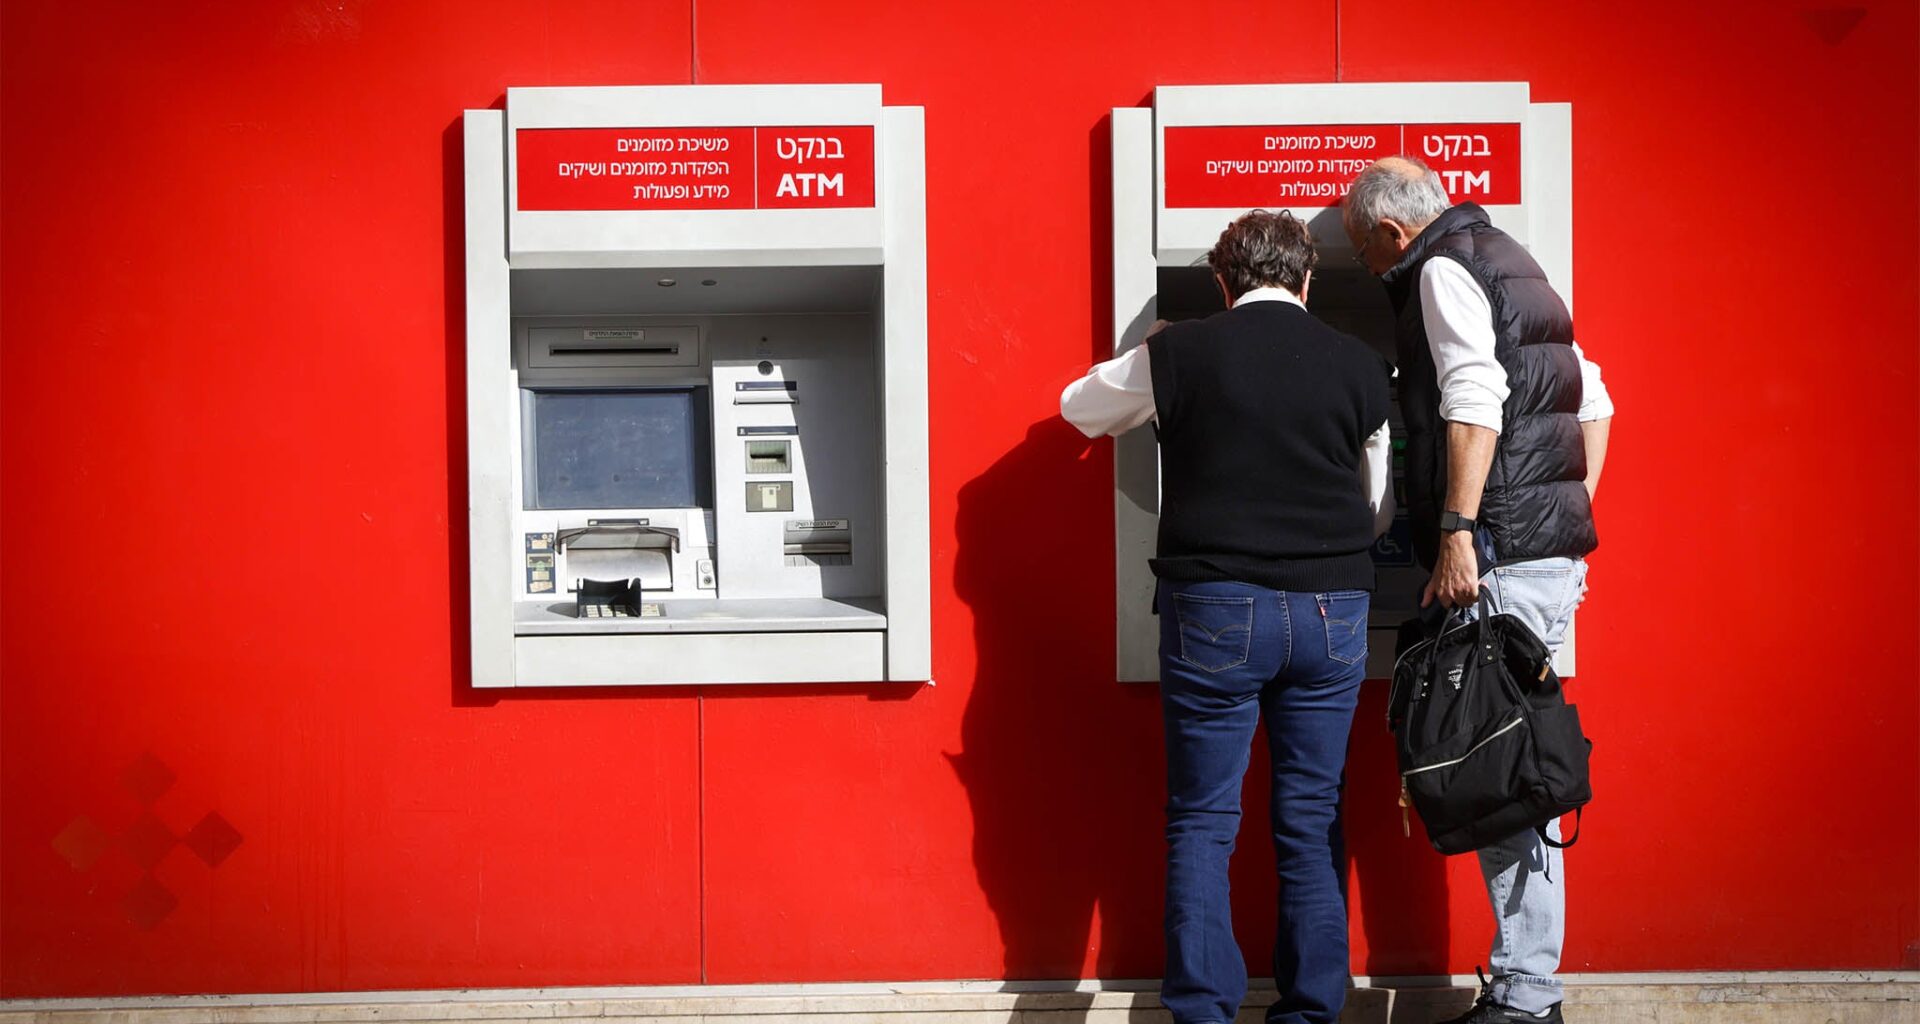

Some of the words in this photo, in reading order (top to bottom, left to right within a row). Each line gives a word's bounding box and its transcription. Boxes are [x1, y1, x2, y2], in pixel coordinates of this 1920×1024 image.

[617, 138, 674, 152] מזומנים
[678, 137, 729, 152] משיכת
[776, 137, 845, 163] בנקט
[1264, 136, 1321, 150] מזומנים
[1324, 135, 1376, 150] משיכת
[1423, 134, 1491, 161] בנקט
[558, 162, 606, 179] ושיקים
[610, 161, 667, 176] מזומנים
[671, 161, 729, 177] הפקדות
[1206, 160, 1254, 177] ושיקים
[1257, 159, 1314, 174] מזומנים
[775, 173, 844, 197] ATM
[1280, 181, 1336, 196] ופעולות
[1435, 170, 1490, 194] TM
[634, 183, 689, 199] ופעולות
[693, 184, 729, 199] מידע
